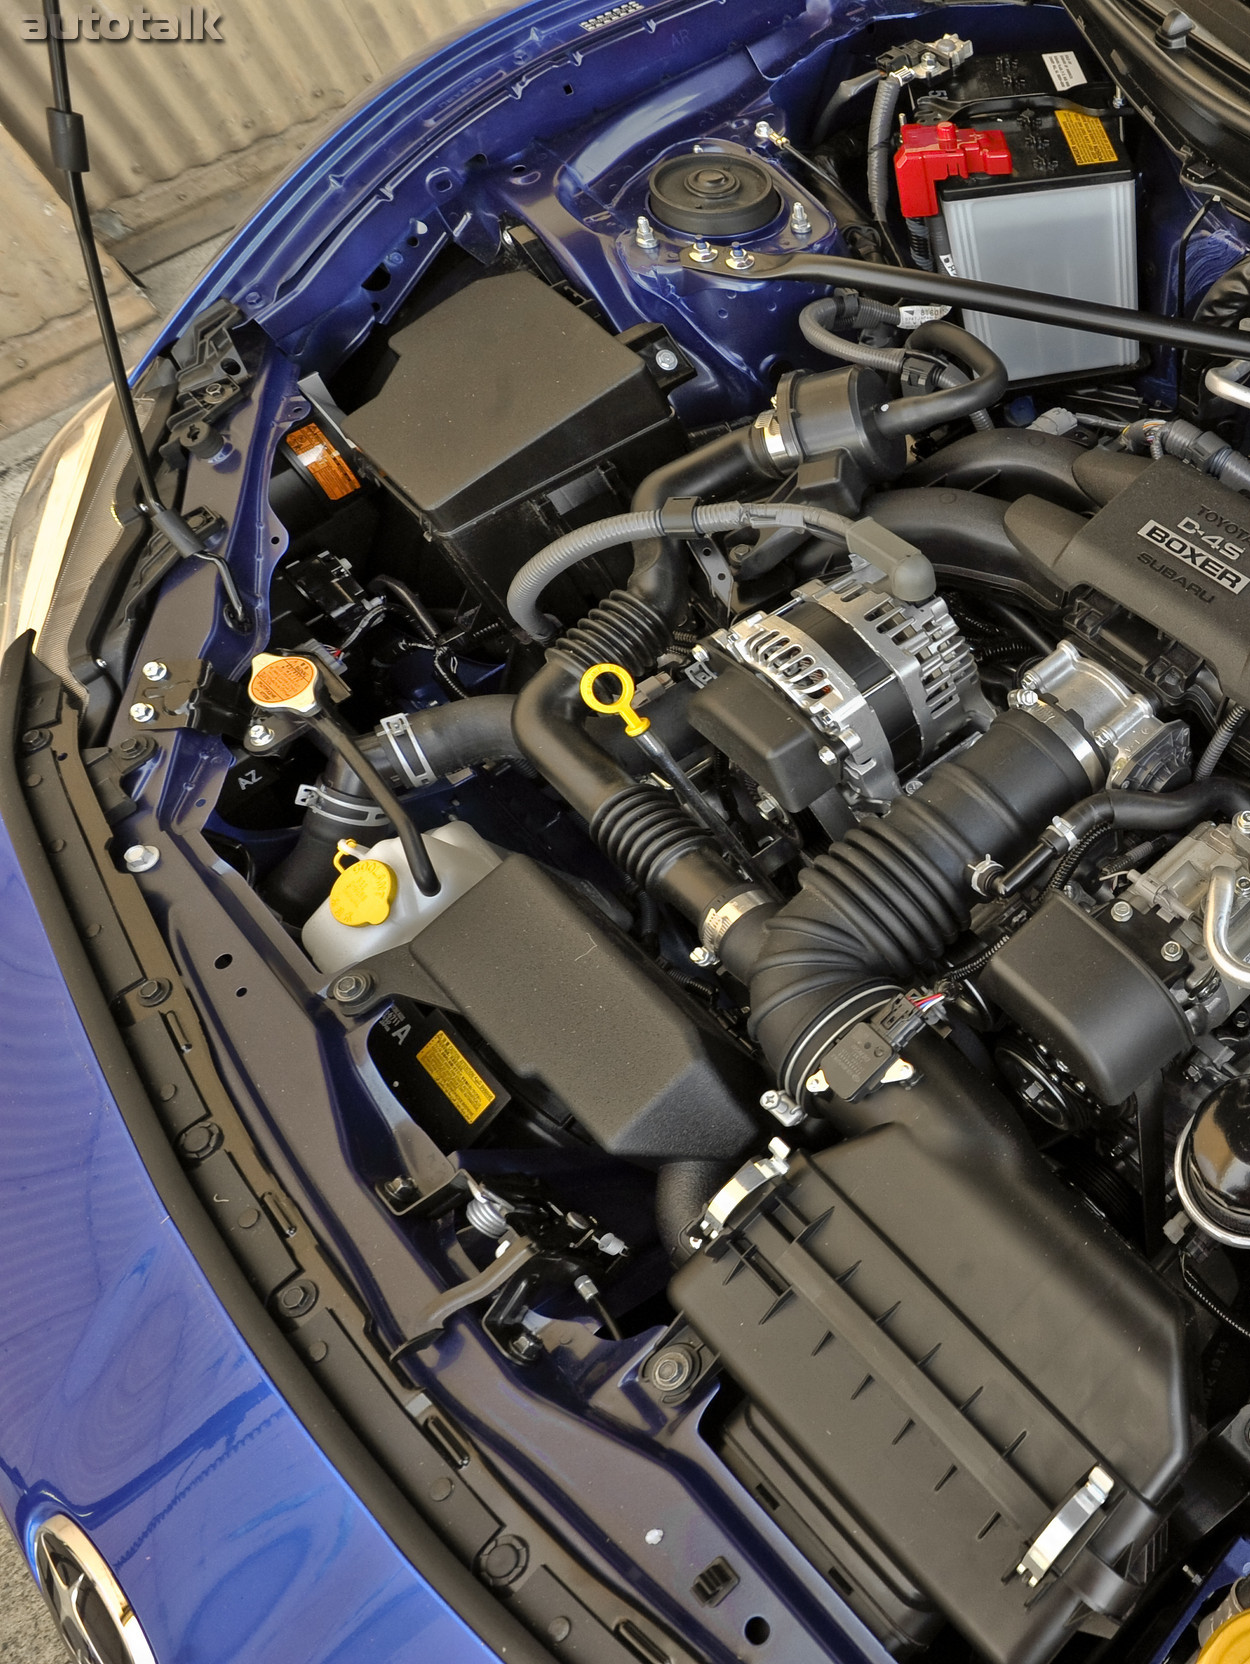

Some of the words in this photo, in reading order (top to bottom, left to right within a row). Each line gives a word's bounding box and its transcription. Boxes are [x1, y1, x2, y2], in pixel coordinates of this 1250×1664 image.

[1145, 525, 1242, 589] BOXER
[1137, 551, 1216, 604] SUBARU
[237, 769, 263, 791] AZ
[391, 1023, 412, 1046] A
